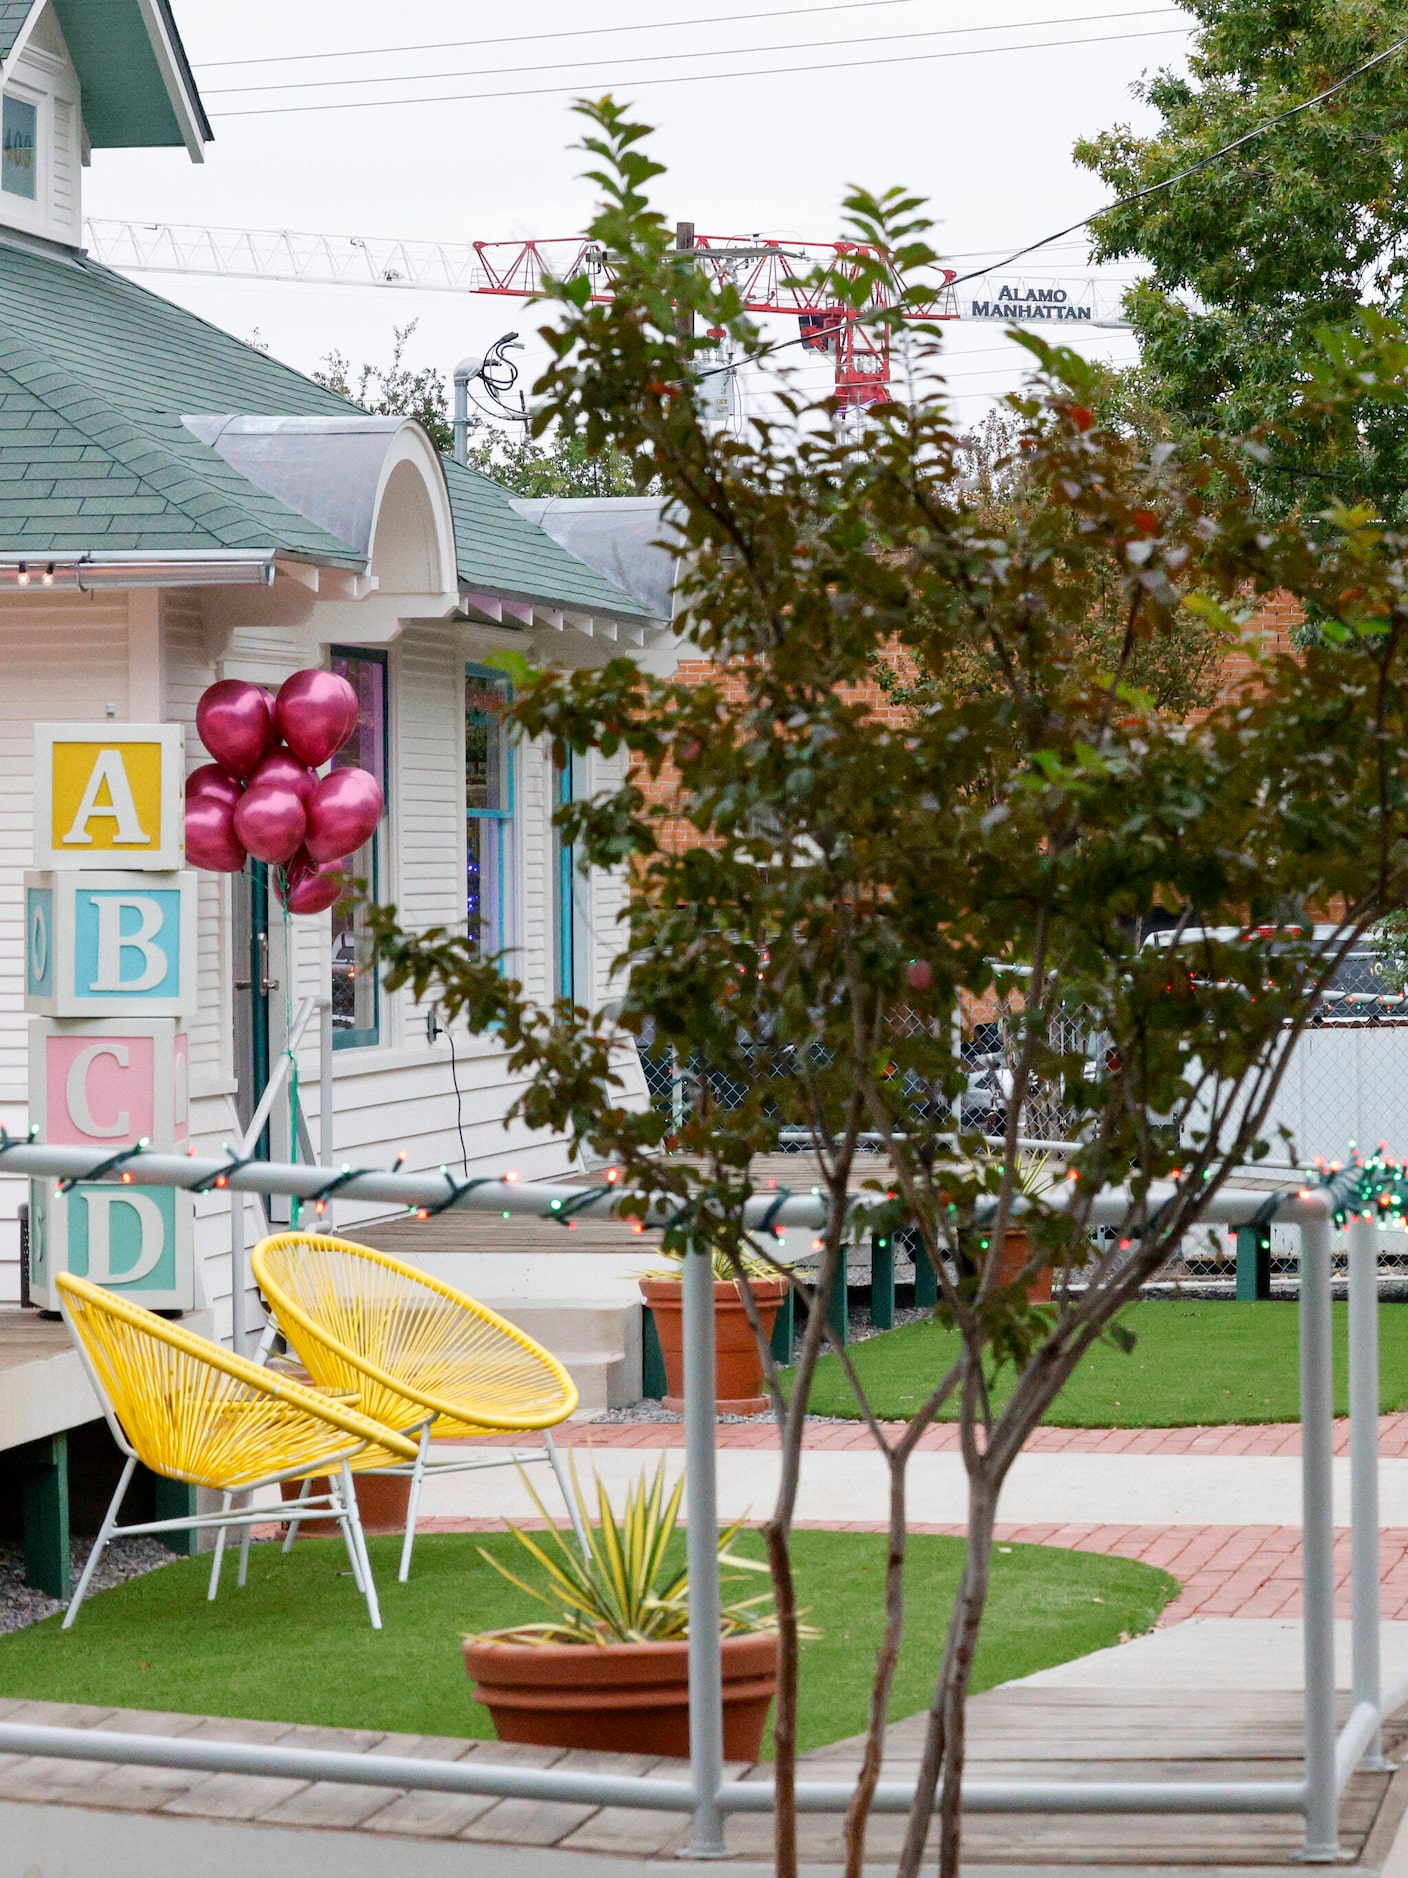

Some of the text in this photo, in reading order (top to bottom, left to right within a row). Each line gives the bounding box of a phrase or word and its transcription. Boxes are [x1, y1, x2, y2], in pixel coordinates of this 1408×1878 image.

[972, 301, 1091, 320] MANHATTAN
[998, 285, 1067, 302] ALAMO
[62, 750, 150, 844] A
[89, 896, 168, 992] B
[66, 1043, 129, 1138] C
[80, 1191, 164, 1284] D
